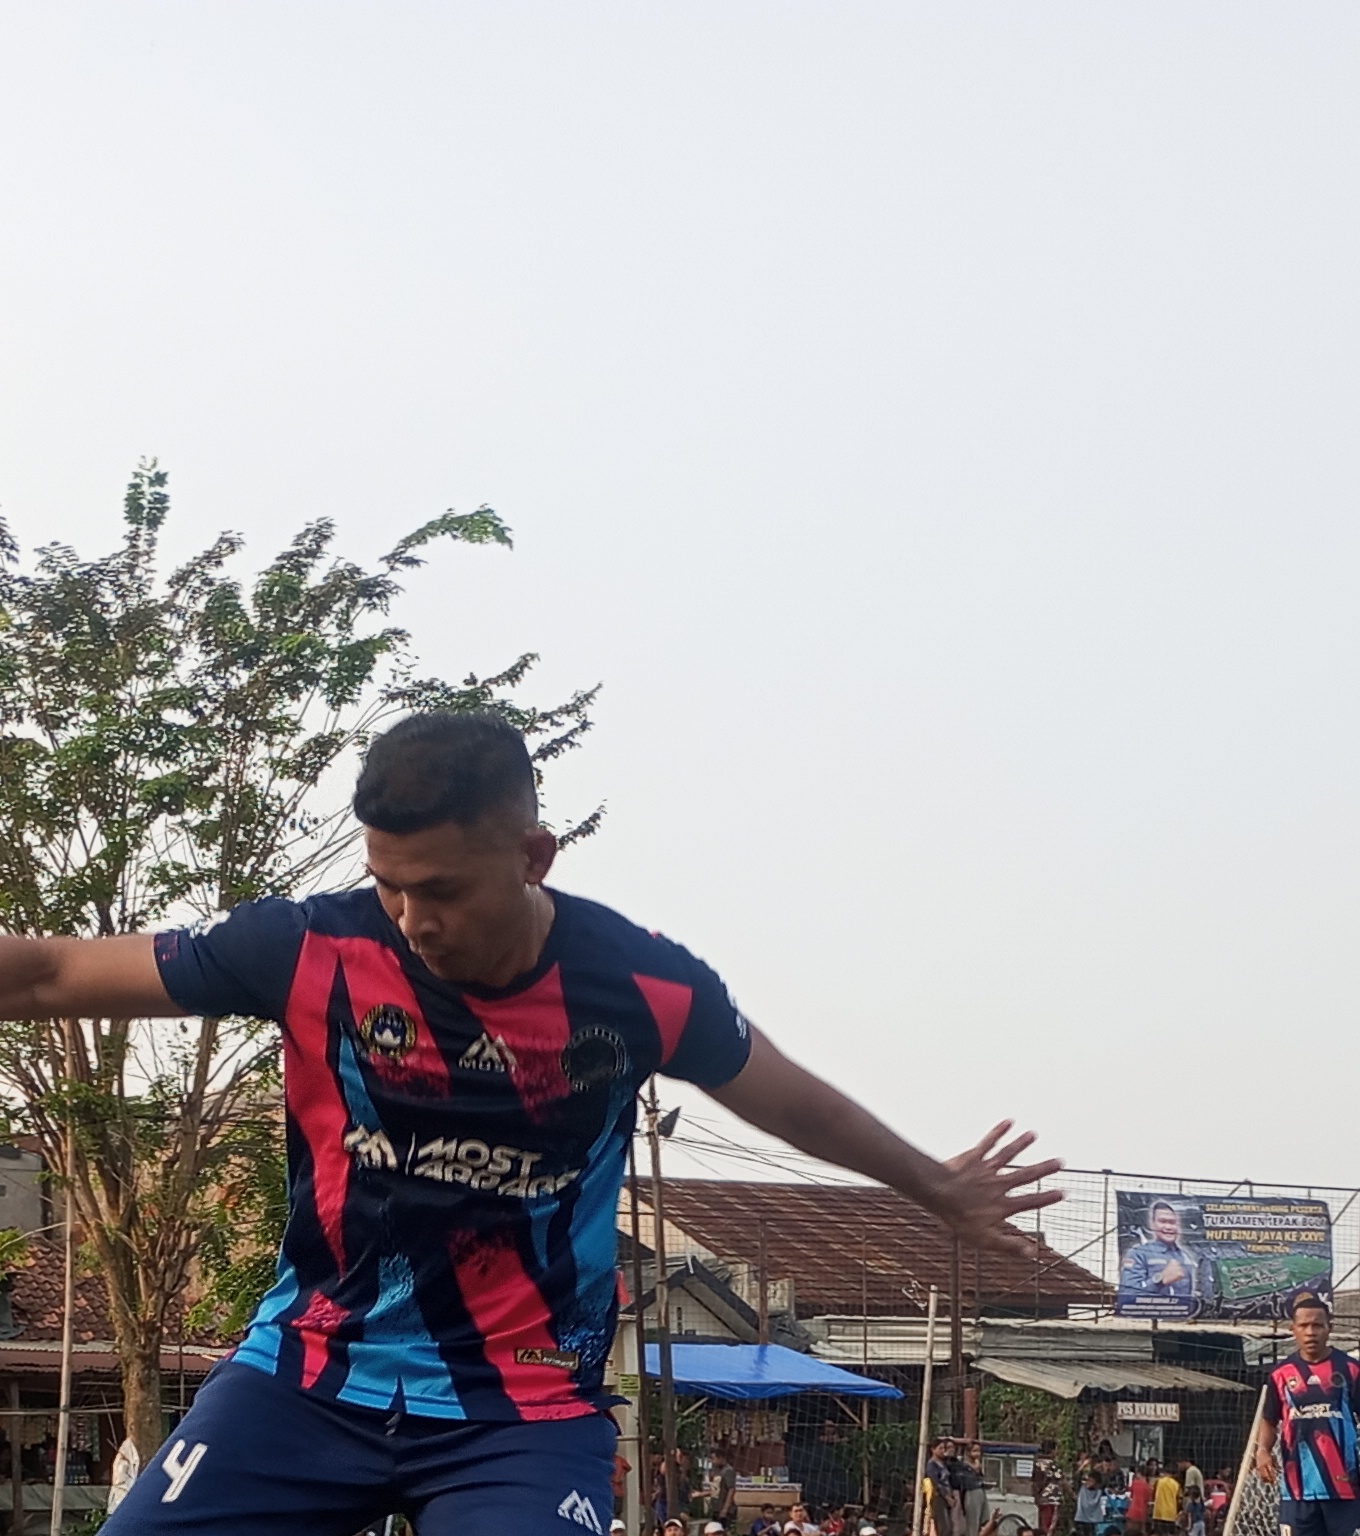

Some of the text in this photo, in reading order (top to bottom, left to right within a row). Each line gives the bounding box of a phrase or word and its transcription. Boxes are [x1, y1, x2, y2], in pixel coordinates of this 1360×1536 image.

[417, 1136, 543, 1181] MOST
[1203, 1214, 1266, 1228] TURNAMEN
[1205, 1230, 1229, 1240] HUT
[1231, 1230, 1258, 1240] BINA
[1258, 1231, 1283, 1242] JAYA
[161, 1439, 208, 1503] 4
